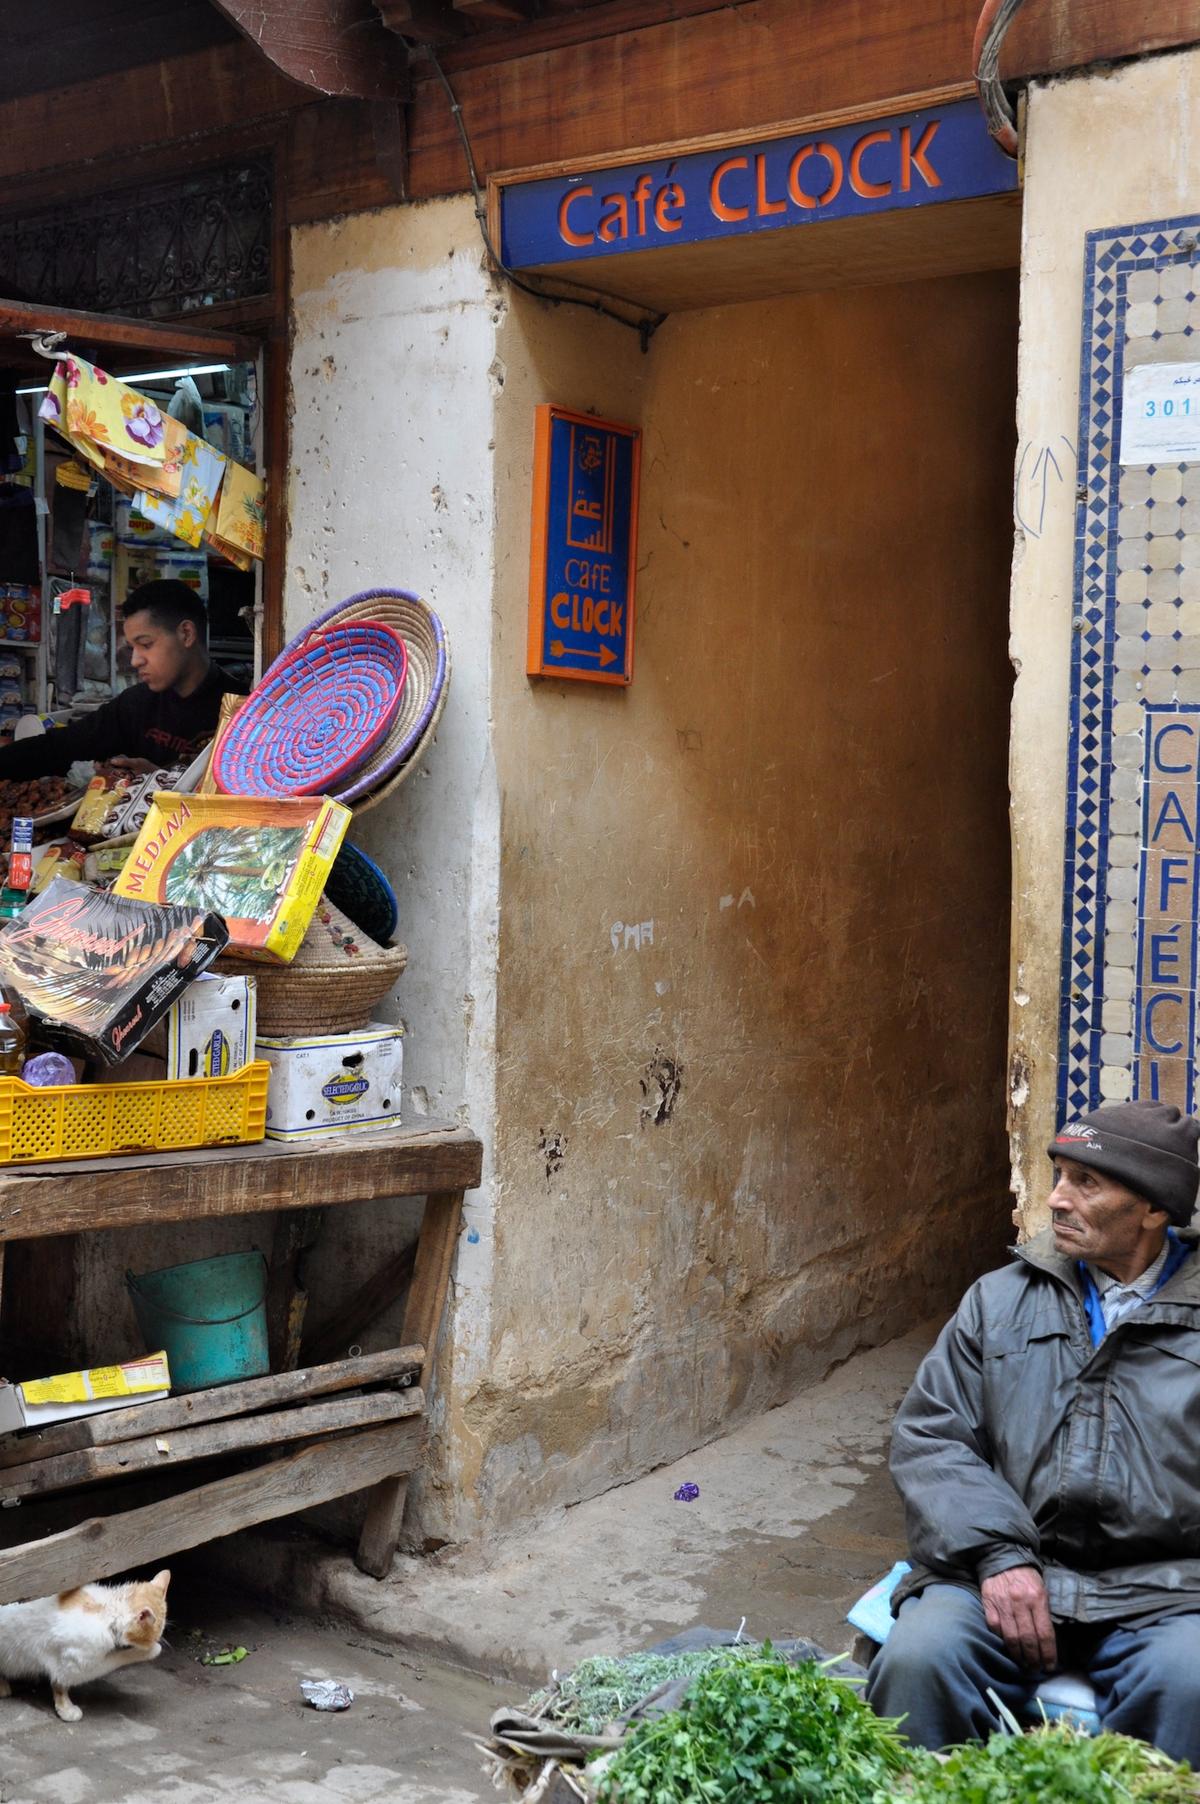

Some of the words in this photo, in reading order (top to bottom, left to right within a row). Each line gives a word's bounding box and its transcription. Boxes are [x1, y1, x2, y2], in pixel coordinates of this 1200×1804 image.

[557, 161, 686, 247] Café
[709, 119, 942, 223] CLOCK
[551, 592, 623, 636] CLOCK
[126, 800, 192, 893] MEDINA
[1151, 723, 1195, 984] CAFÉ
[1064, 1122, 1098, 1138] NIKE
